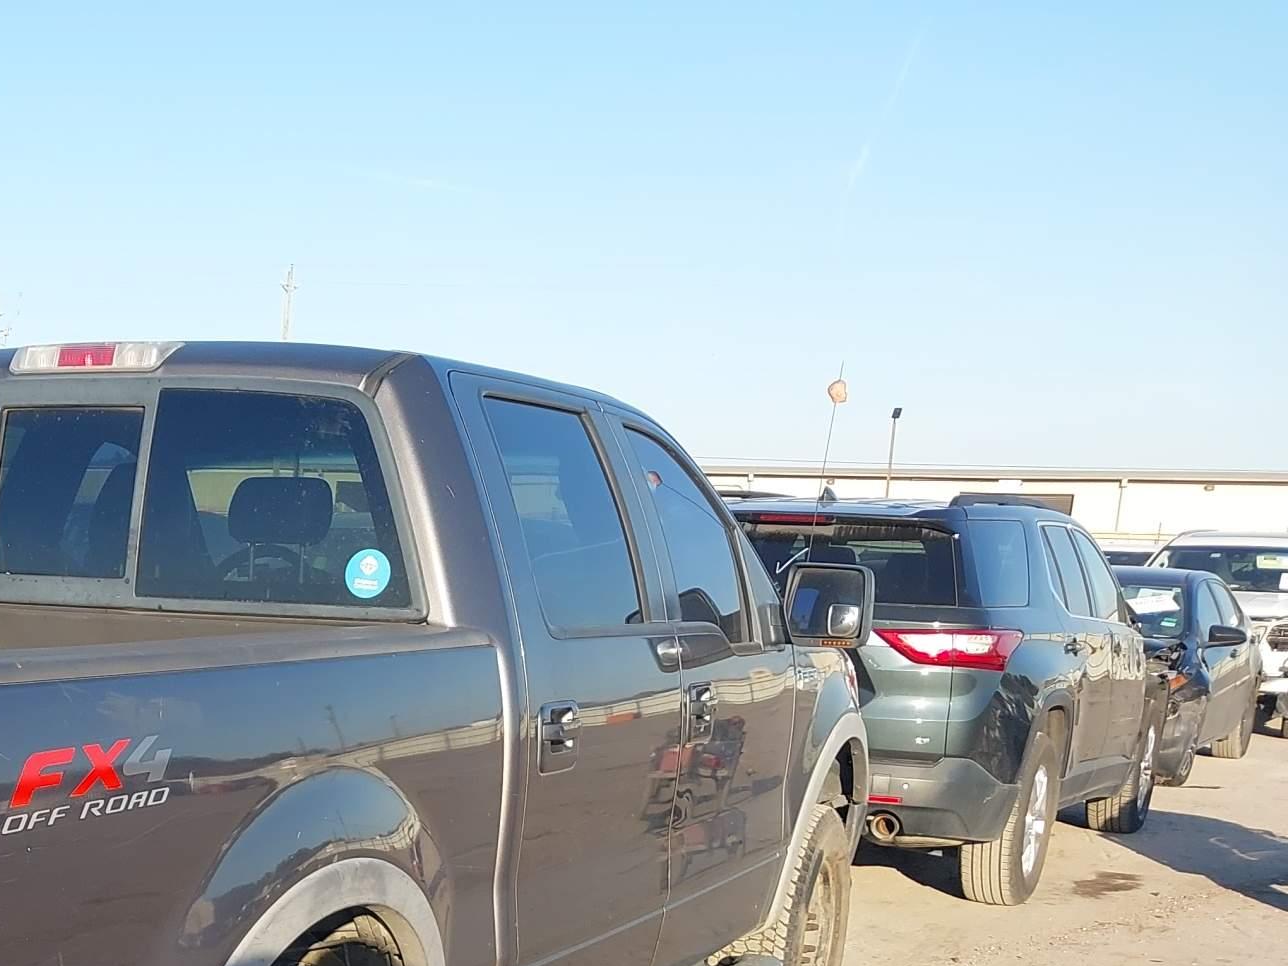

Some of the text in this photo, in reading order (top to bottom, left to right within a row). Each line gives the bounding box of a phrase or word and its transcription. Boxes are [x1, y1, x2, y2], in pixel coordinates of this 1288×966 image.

[9, 735, 173, 808] FX4
[1, 786, 170, 835] OFF ROAD
